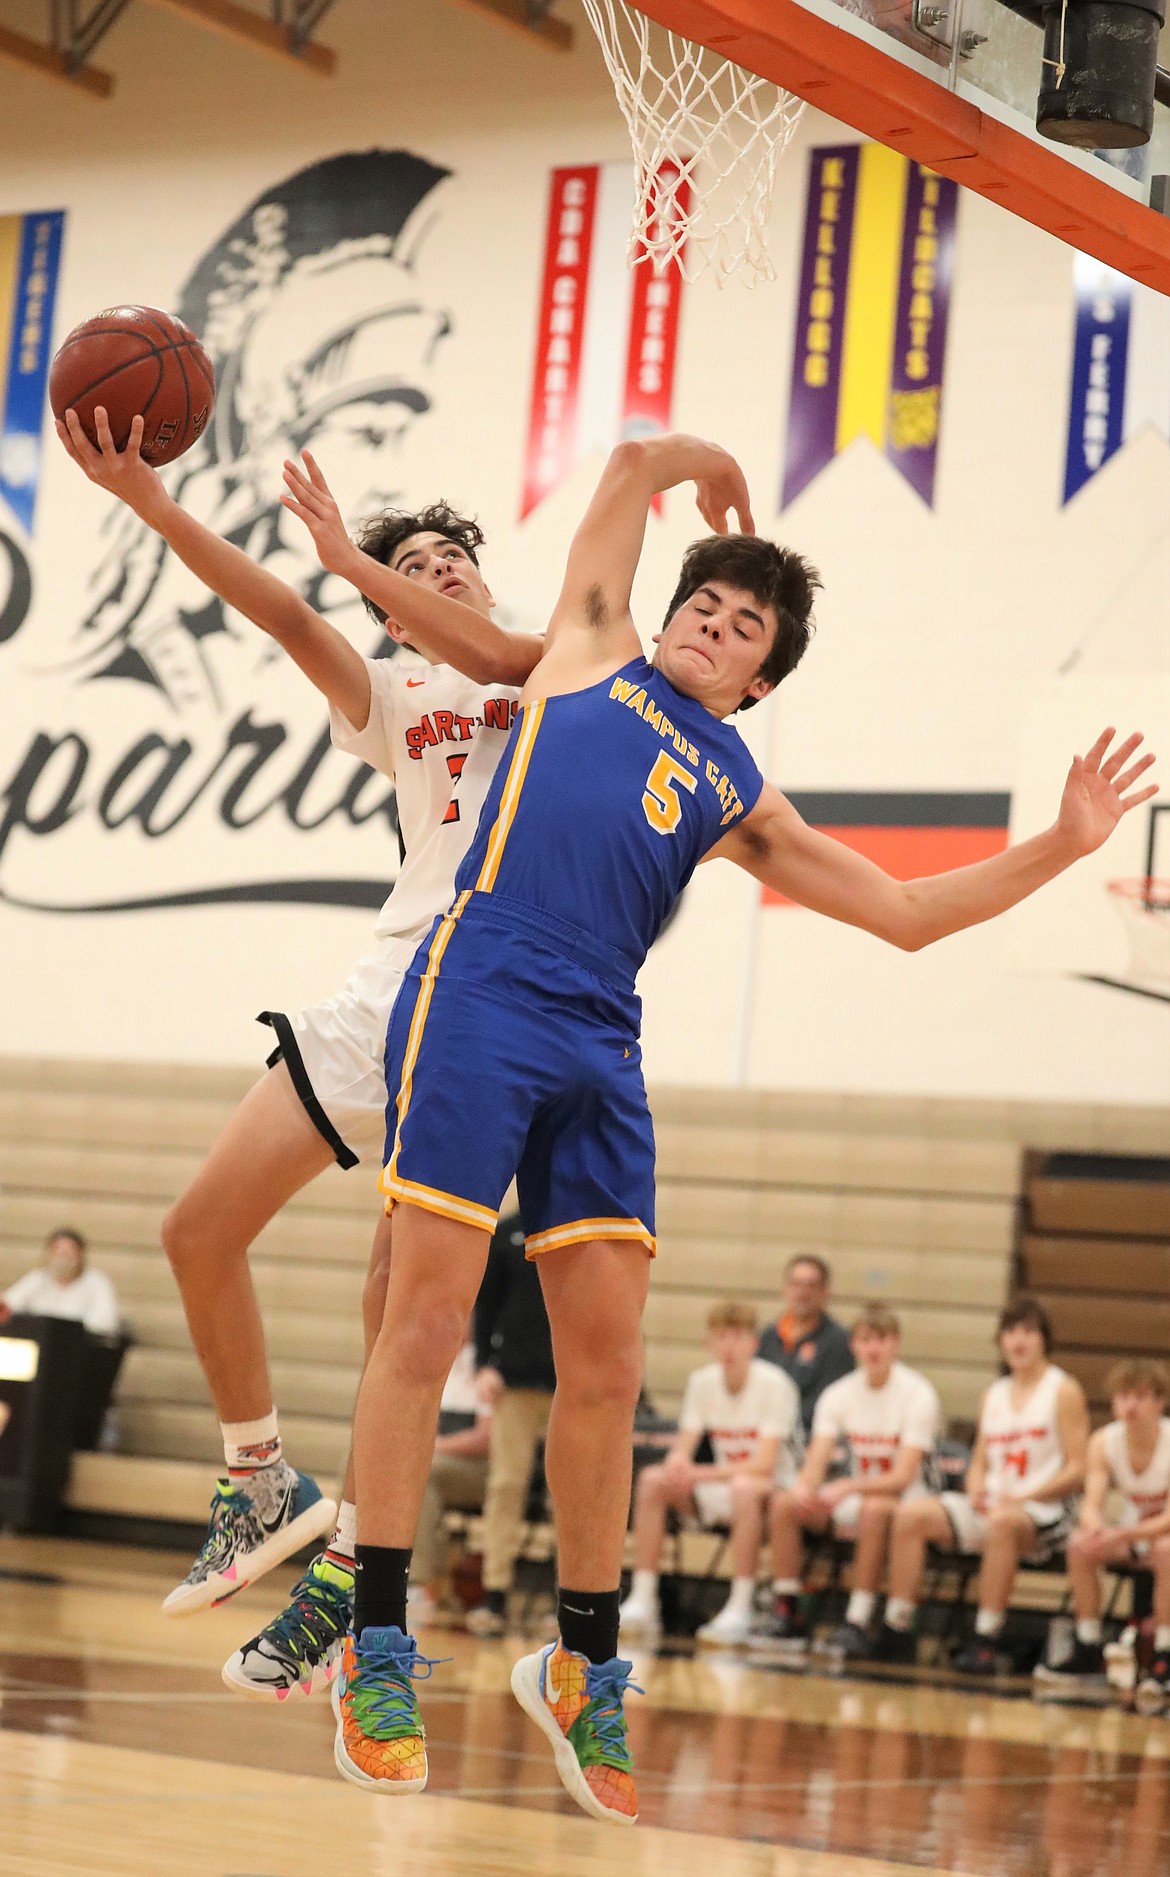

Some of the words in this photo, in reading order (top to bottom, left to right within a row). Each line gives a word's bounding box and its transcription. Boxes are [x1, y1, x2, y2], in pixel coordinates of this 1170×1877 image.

[803, 157, 844, 388] KELLOGG
[905, 162, 942, 381] ILDCATS
[609, 676, 700, 767] WAMPUS
[705, 759, 744, 826] CATS
[641, 748, 699, 836] 5
